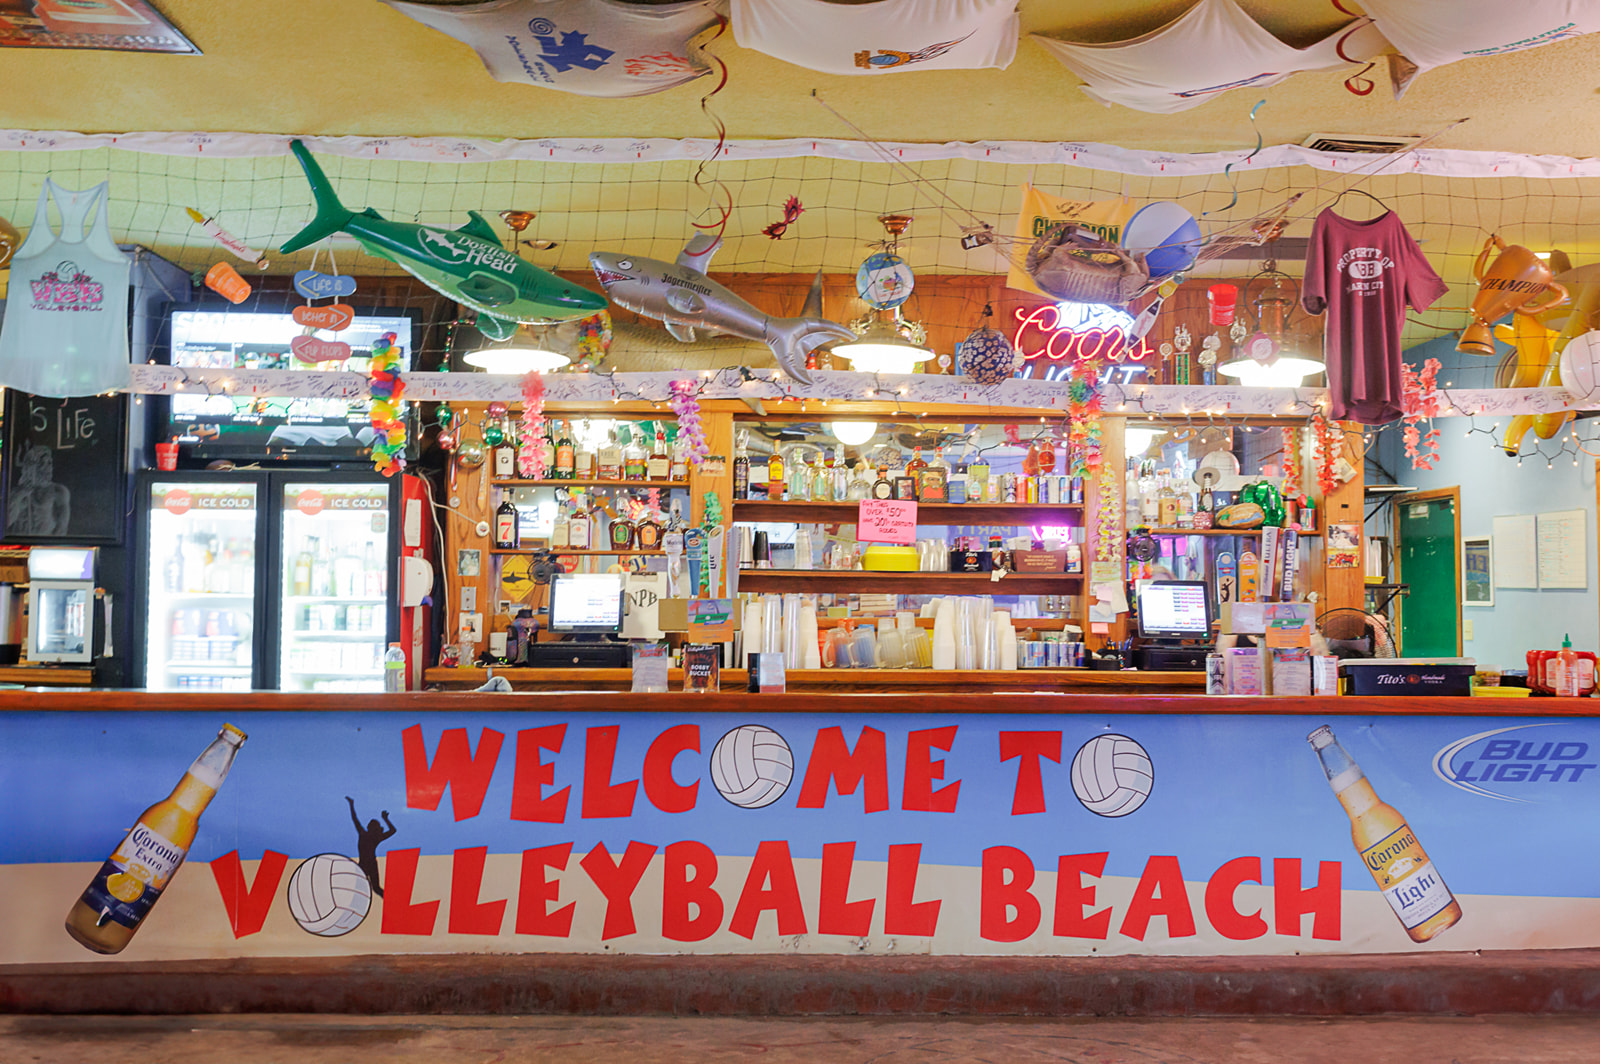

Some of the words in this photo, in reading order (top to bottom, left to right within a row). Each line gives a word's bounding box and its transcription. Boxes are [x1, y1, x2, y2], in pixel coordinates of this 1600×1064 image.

[465, 248, 518, 275] Head
[1336, 247, 1382, 273] PROPERTY
[1014, 305, 1154, 362] Coors
[198, 498, 217, 508] ICE
[219, 498, 250, 508] COLD
[331, 499, 350, 508] ICE
[352, 499, 383, 508] COLD
[500, 521, 513, 540] 7
[1285, 539, 1296, 569] LIGHT
[1283, 572, 1294, 592] BUD
[629, 588, 658, 608] NPB
[1377, 673, 1406, 685] Tito's
[1479, 739, 1589, 761] BUD
[1454, 761, 1597, 783] LIGHT
[131, 827, 180, 865] Corona
[135, 846, 163, 871] Extra
[1366, 833, 1416, 872] Corona
[980, 845, 1343, 943] BEACH
[1391, 873, 1436, 911] Light
